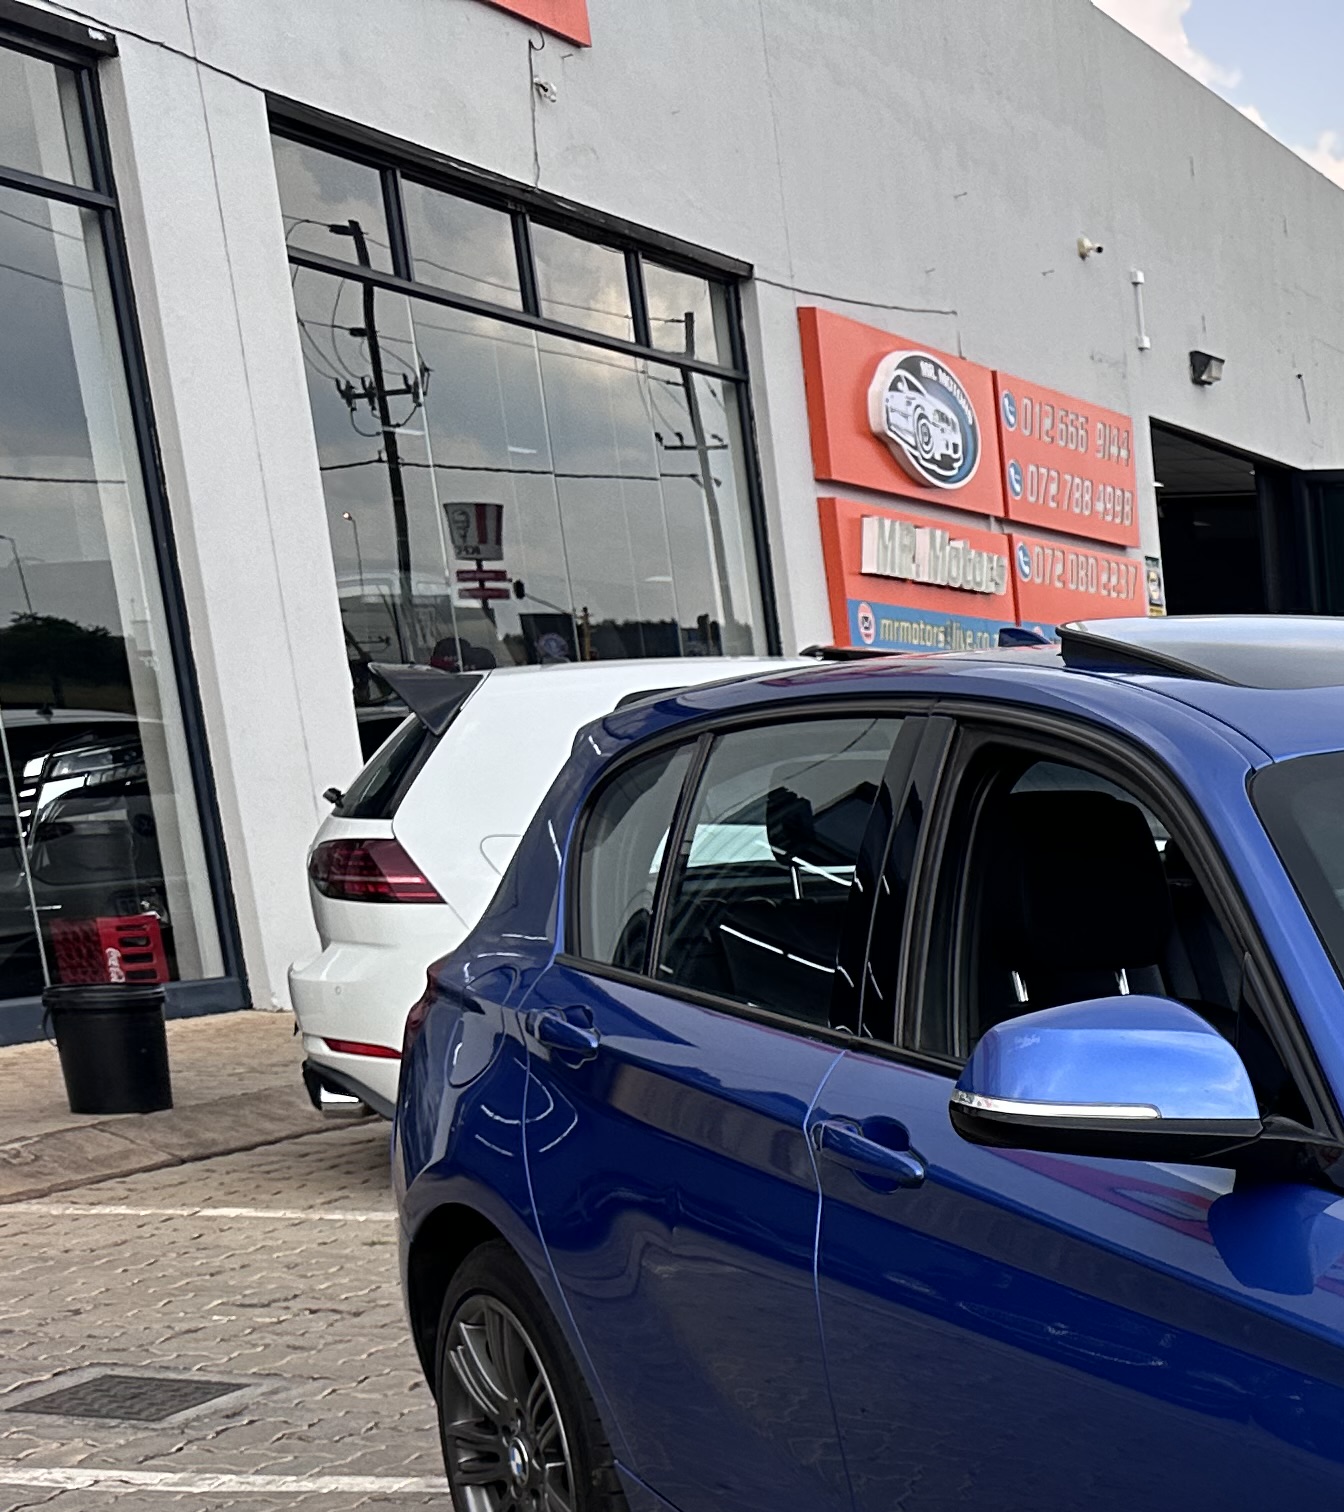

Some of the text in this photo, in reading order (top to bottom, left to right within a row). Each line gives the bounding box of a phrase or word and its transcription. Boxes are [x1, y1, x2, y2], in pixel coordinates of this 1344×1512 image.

[1022, 397, 1054, 443] 012
[1058, 408, 1088, 453] 666
[1027, 463, 1060, 509] 072
[1063, 473, 1093, 516] 788
[917, 528, 1008, 596] Motors
[1033, 545, 1065, 589] 072
